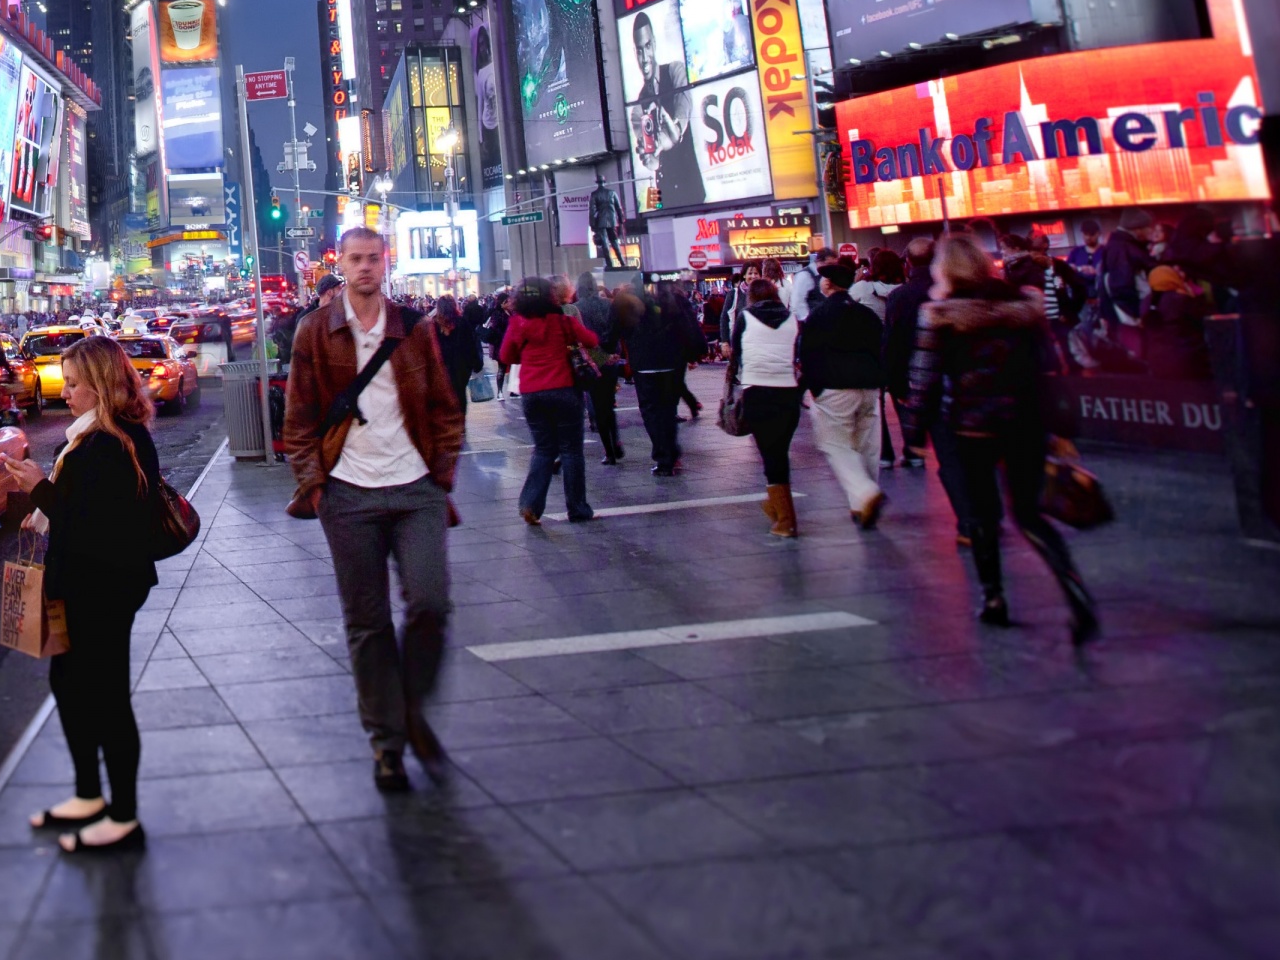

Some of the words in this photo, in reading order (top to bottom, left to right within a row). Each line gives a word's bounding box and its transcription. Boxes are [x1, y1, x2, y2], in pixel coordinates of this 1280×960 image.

[330, 41, 342, 54] &
[258, 74, 282, 82] STOPPING
[702, 86, 754, 152] SO
[554, 129, 565, 137] JUNE
[707, 131, 755, 166] Kodak
[850, 127, 947, 184] Bank
[951, 117, 993, 171] of
[507, 215, 538, 224] Broadway
[727, 217, 811, 228] MARQUIS
[731, 242, 810, 260] WONDERLAND
[1080, 395, 1174, 426] FATHER
[5, 567, 26, 586] AMER
[4, 596, 26, 614] EAGLE
[3, 613, 25, 633] SINCE
[2, 628, 19, 647] 1977
